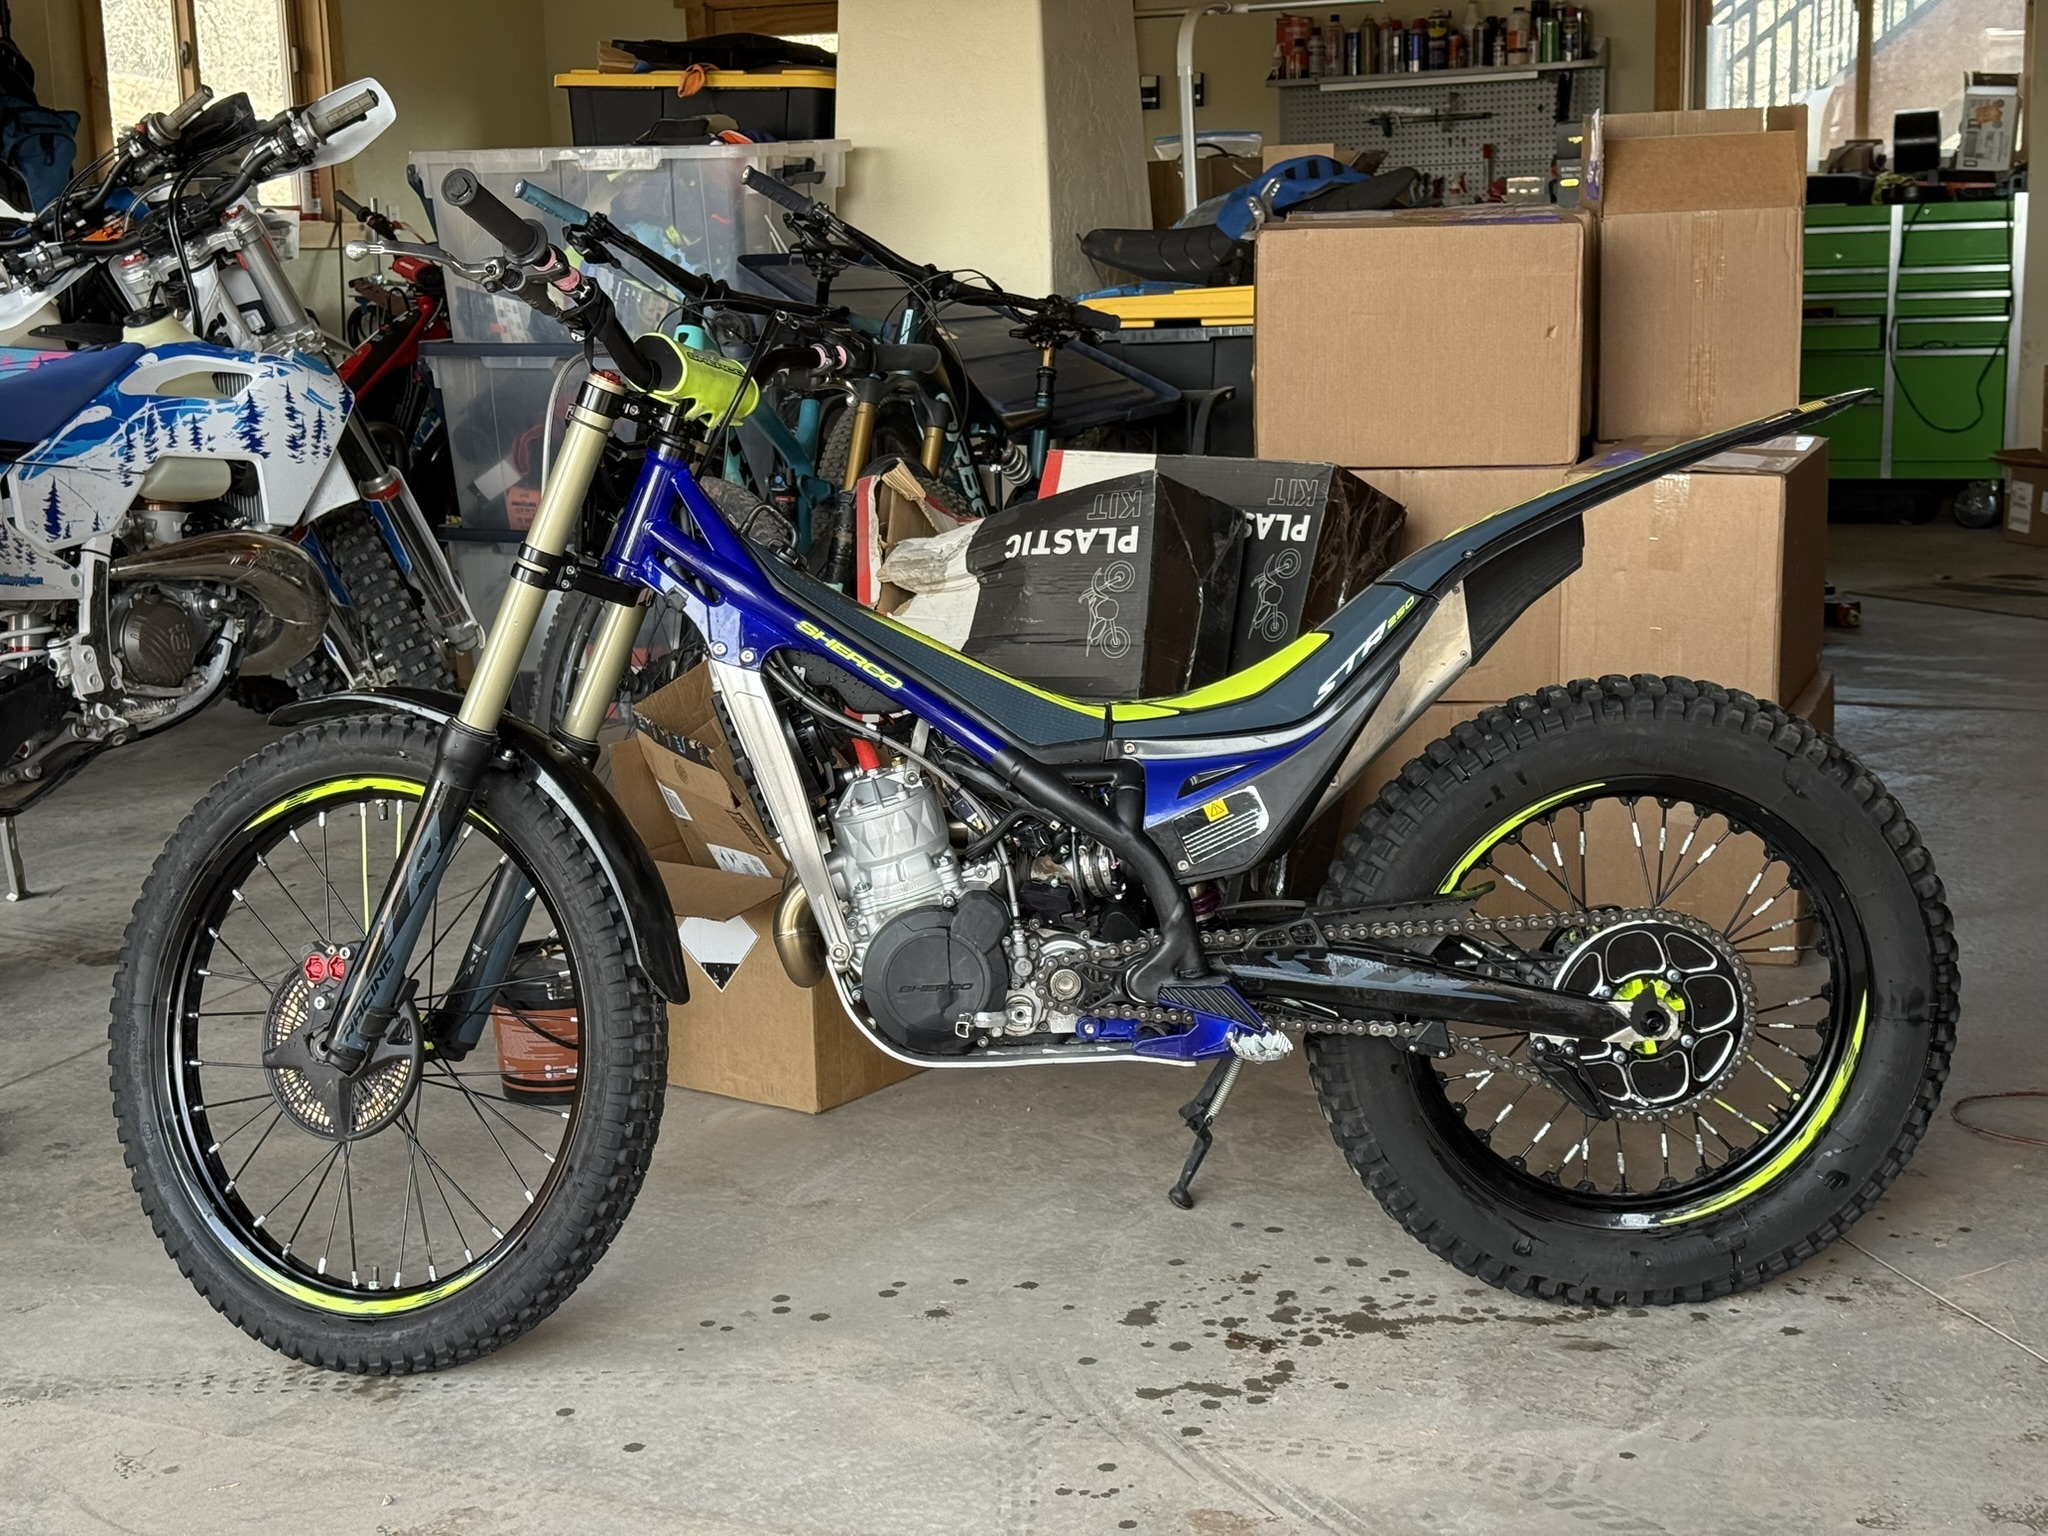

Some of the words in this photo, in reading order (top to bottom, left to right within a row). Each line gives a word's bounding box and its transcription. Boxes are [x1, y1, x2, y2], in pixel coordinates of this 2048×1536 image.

[1086, 490, 1142, 520] KIT
[1267, 478, 1319, 507] KIT
[1004, 525, 1139, 559] PLASTIC
[795, 620, 904, 690] SHERCO
[1313, 619, 1388, 708] STR
[1387, 595, 1415, 630] 250
[344, 953, 395, 1041] RACING
[899, 983, 974, 993] SHERCO
